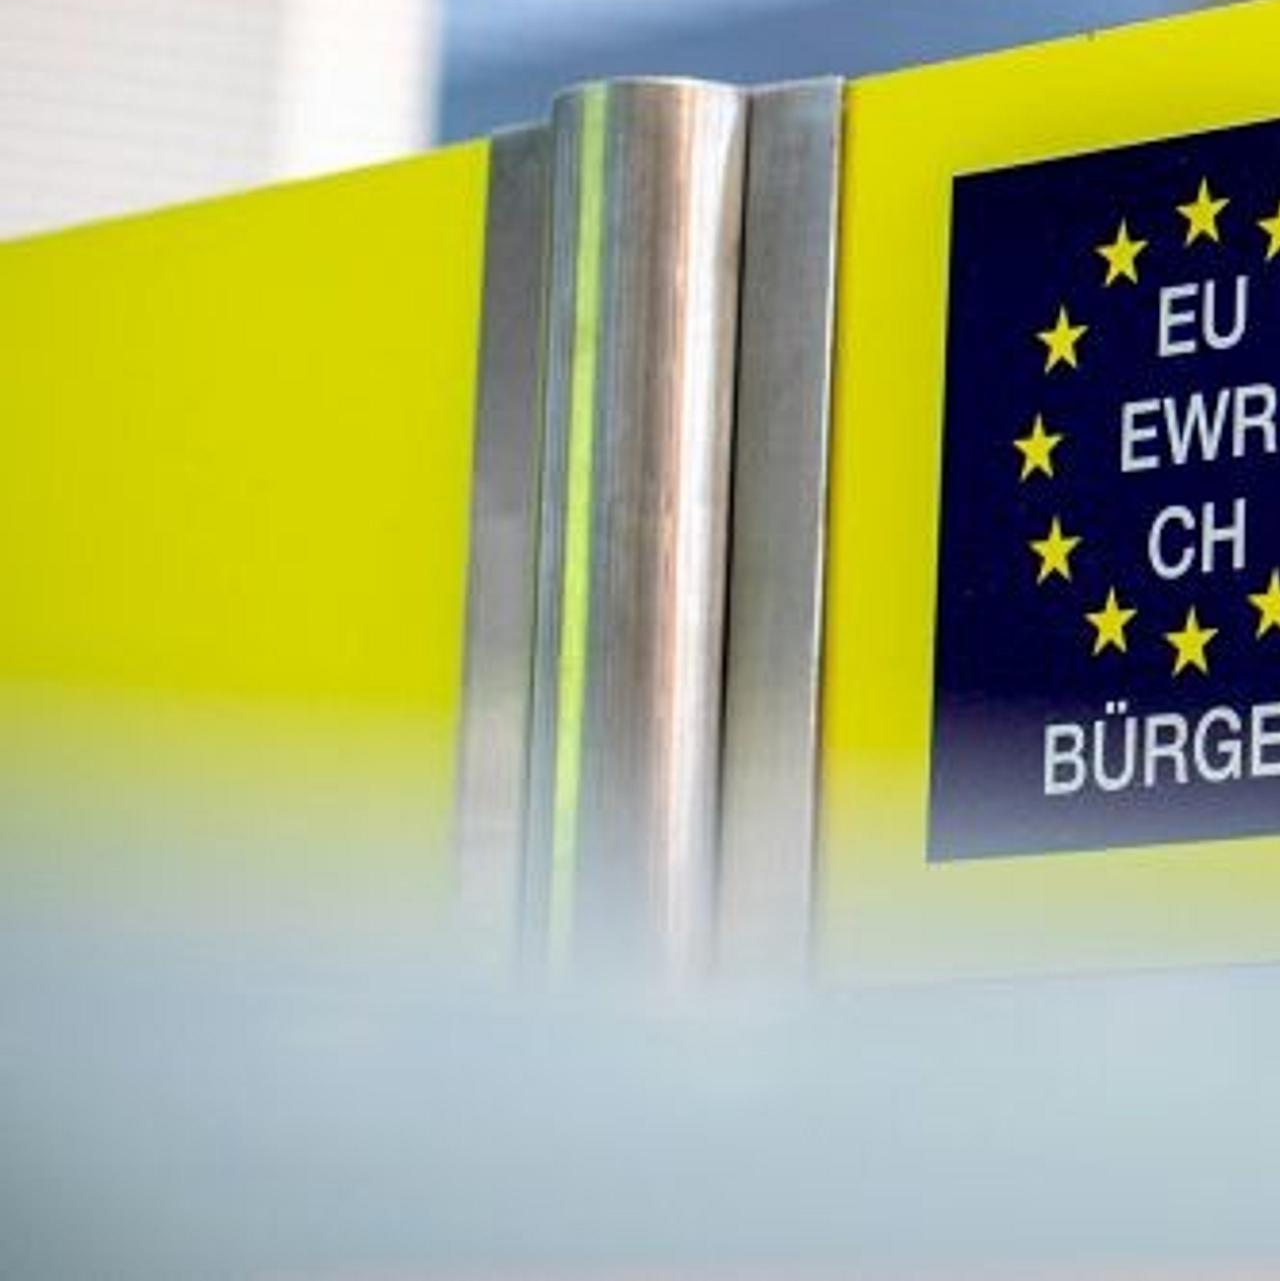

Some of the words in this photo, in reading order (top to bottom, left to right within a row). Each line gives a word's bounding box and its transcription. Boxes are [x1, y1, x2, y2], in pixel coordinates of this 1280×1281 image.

[1158, 274, 1248, 358] EU
[1120, 382, 1278, 473] EWR
[1147, 497, 1247, 580] CH
